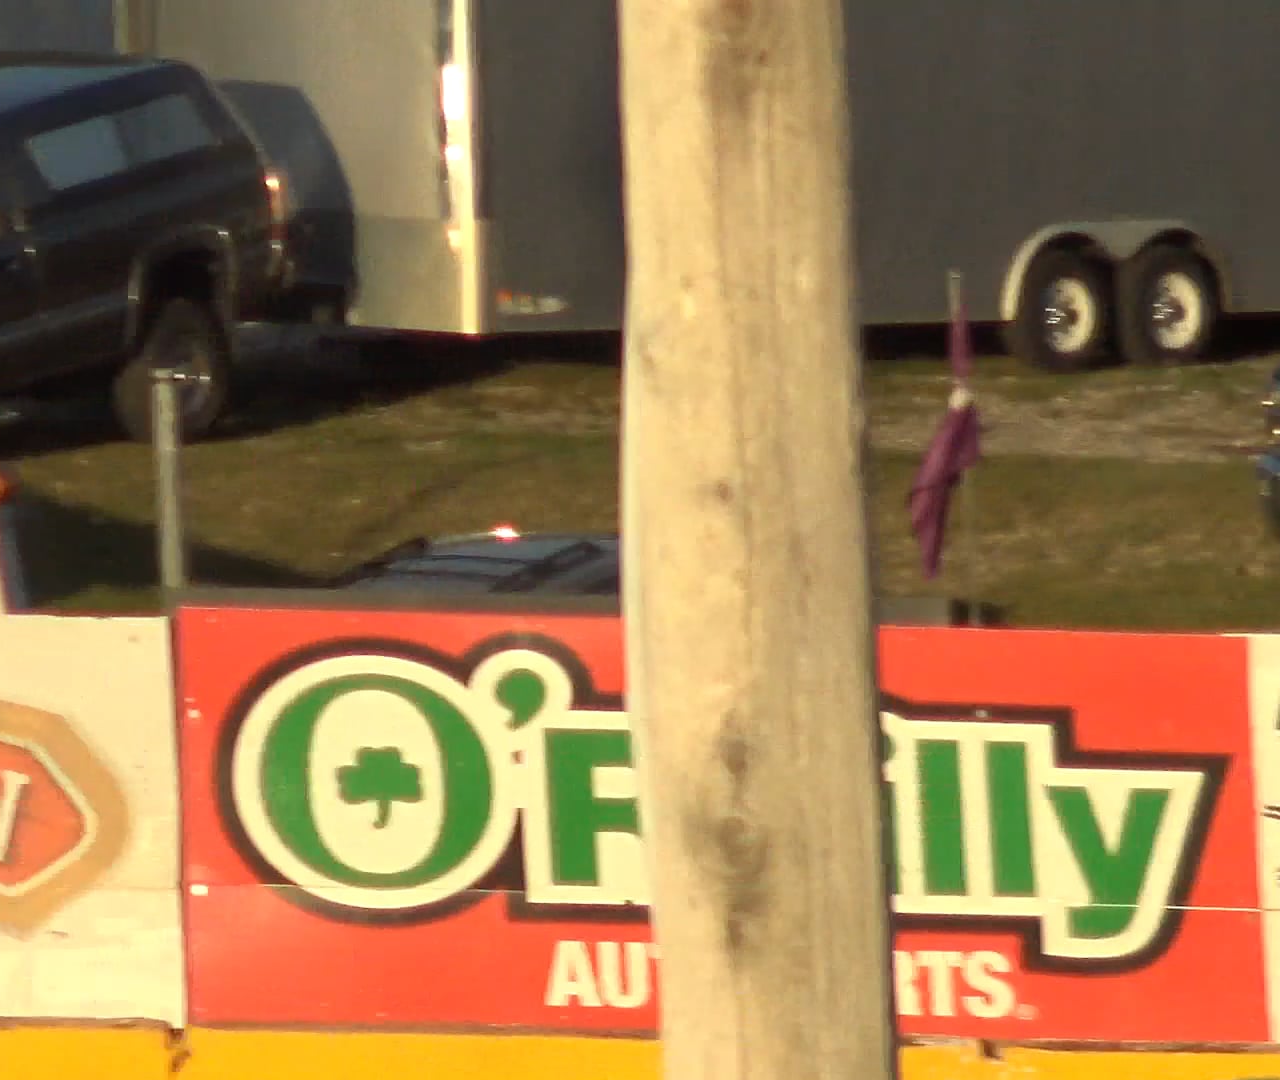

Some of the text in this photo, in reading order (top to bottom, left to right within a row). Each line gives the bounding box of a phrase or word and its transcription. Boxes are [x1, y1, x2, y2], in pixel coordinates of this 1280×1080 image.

[230, 642, 1210, 962] O'Rlly
[545, 939, 1014, 1020] AU RTS
